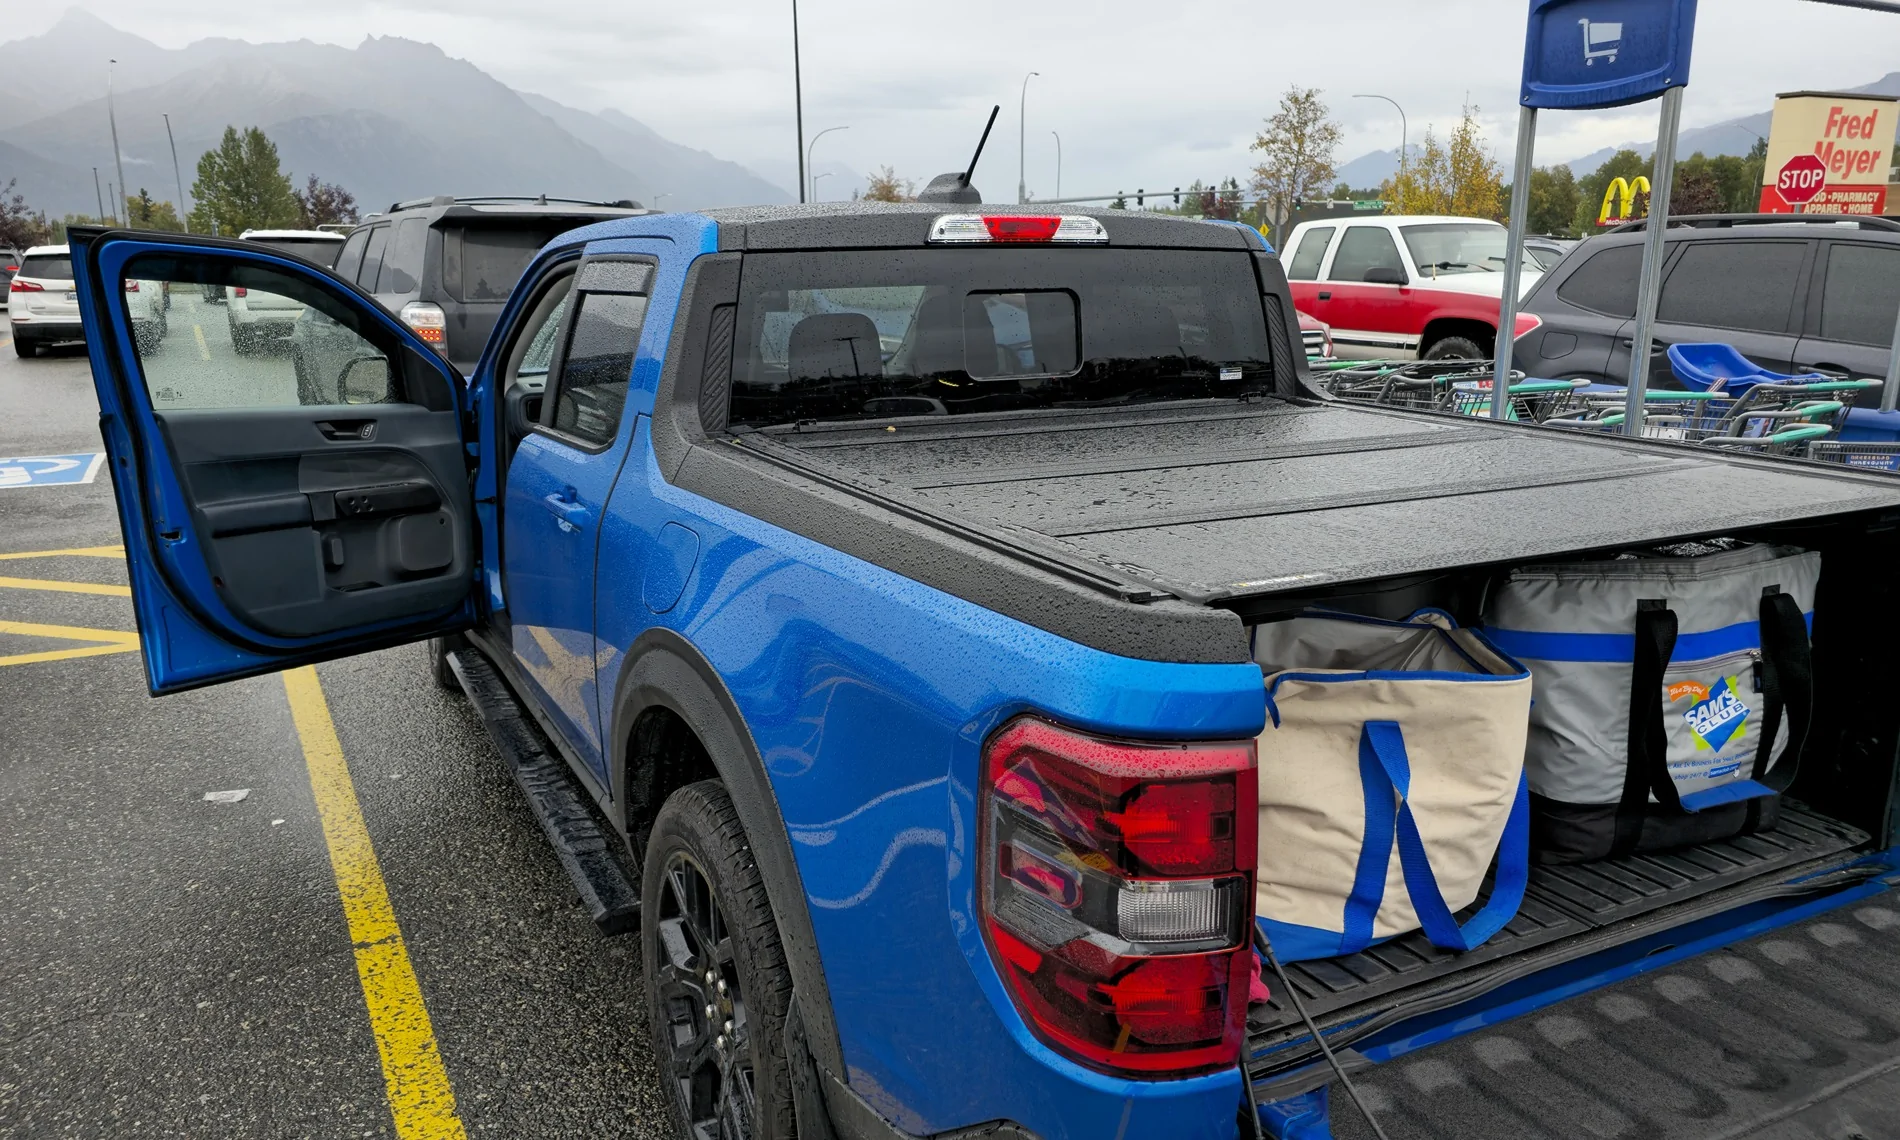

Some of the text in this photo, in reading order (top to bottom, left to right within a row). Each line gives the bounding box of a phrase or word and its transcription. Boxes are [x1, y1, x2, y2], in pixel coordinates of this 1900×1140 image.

[1824, 106, 1878, 139] Fred
[1814, 141, 1881, 180] Meyer
[1779, 169, 1823, 189] STOP
[1803, 204, 1874, 214] APPAREL HOME
[1831, 192, 1879, 203] PHARMACY
[1685, 688, 1737, 727] SAM'S
[1697, 703, 1743, 734] CLUB
